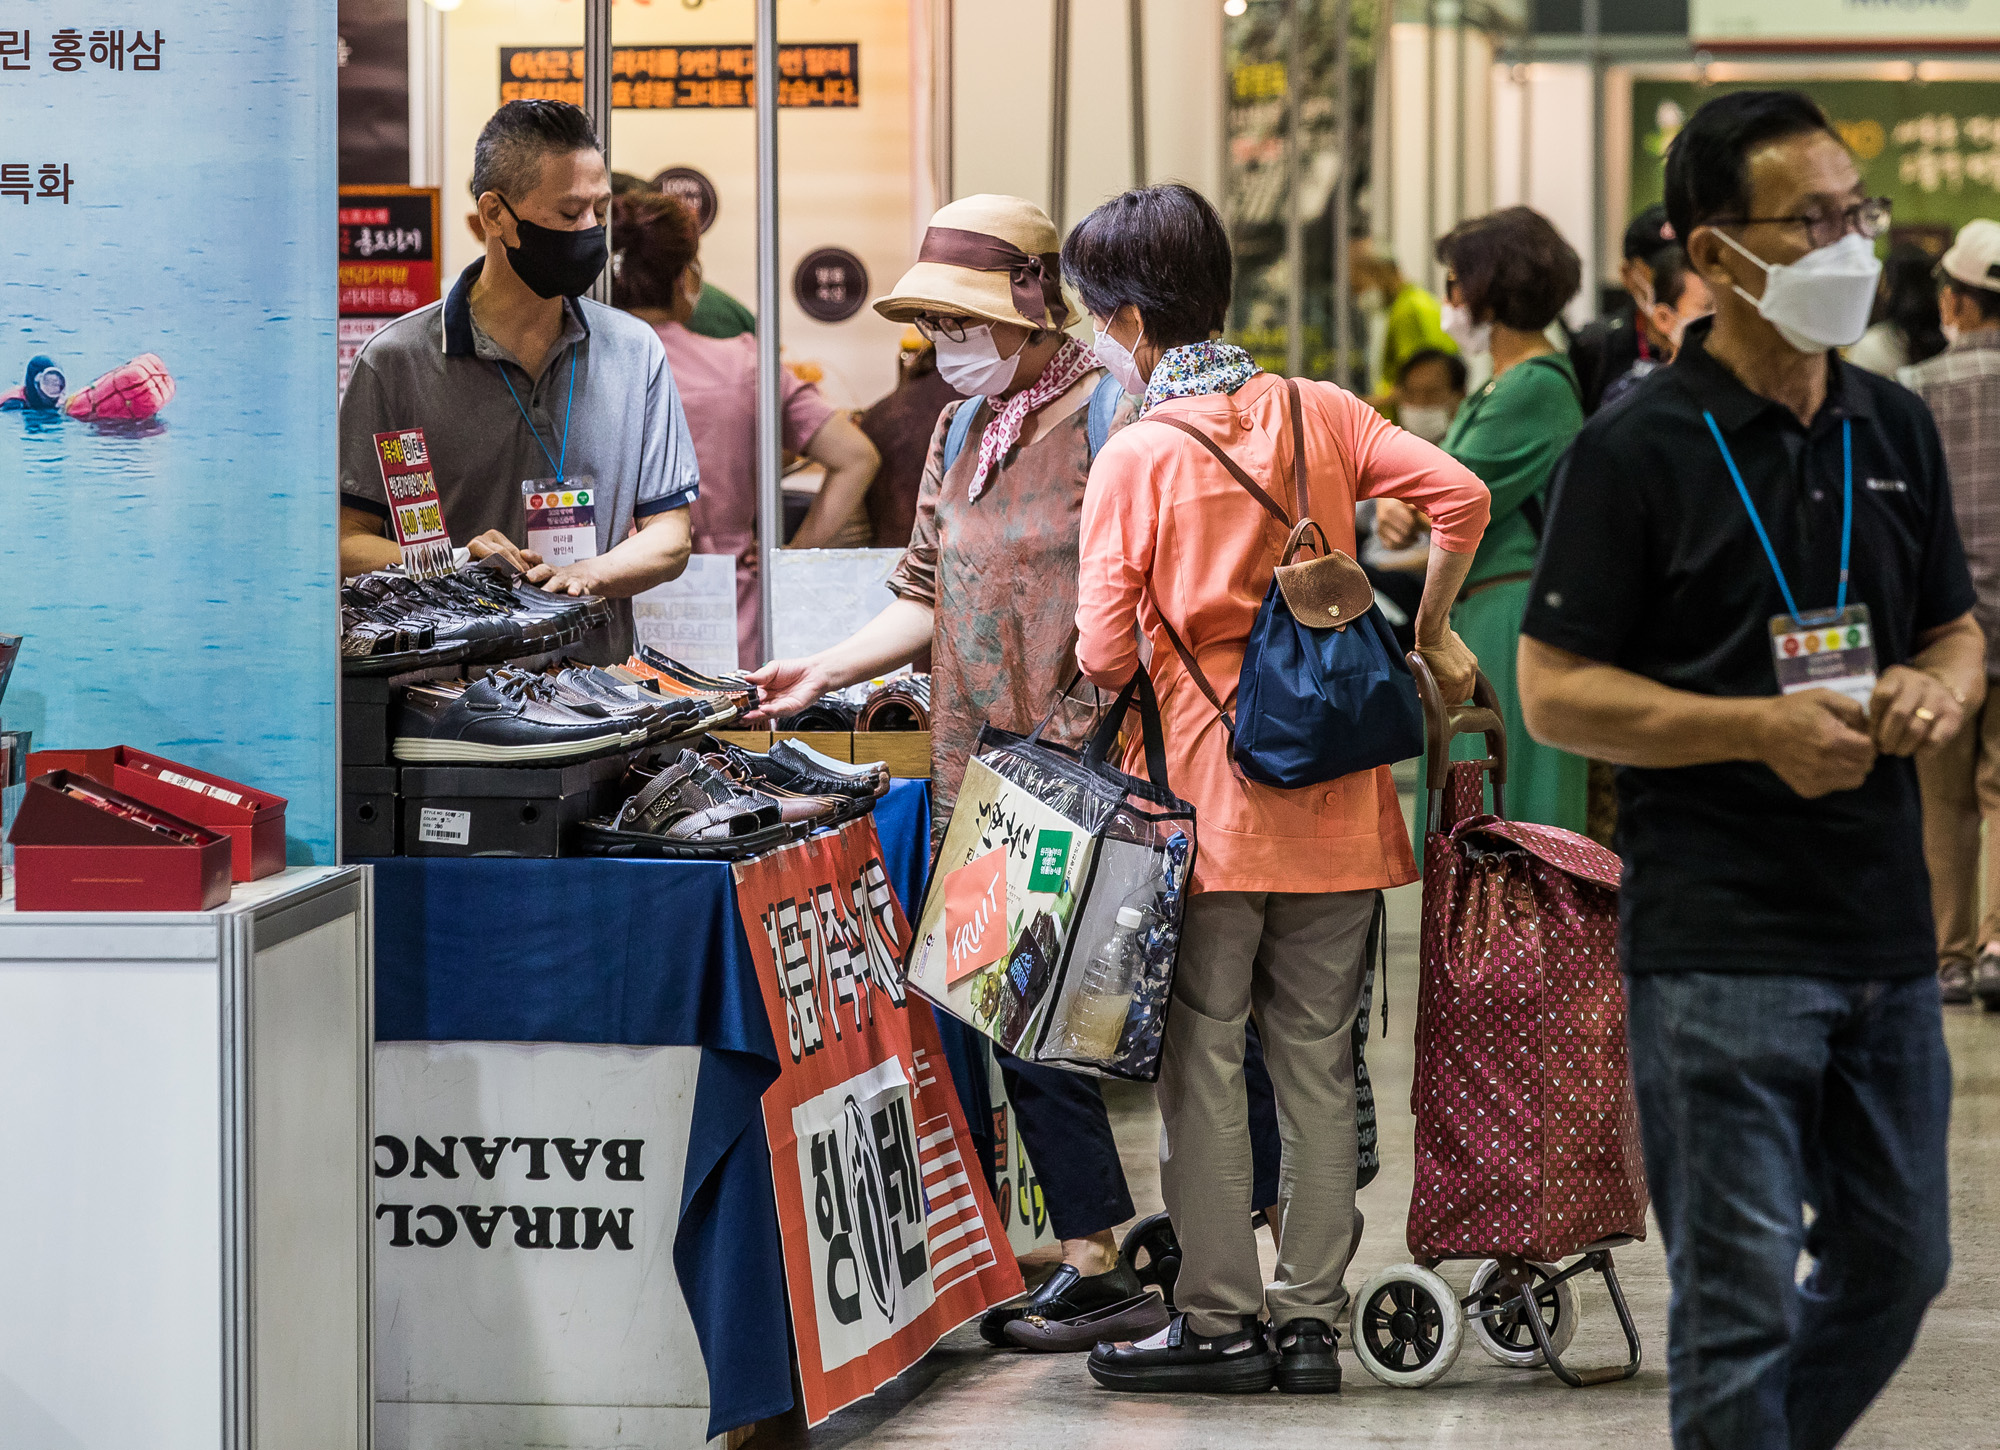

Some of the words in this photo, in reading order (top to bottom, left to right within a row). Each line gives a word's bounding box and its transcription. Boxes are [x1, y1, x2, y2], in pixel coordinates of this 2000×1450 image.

[49, 29, 166, 72] 홍해삼
[0, 163, 74, 205] 특화
[951, 872, 1000, 971] FRUIT
[376, 1203, 635, 1251] MIRACL
